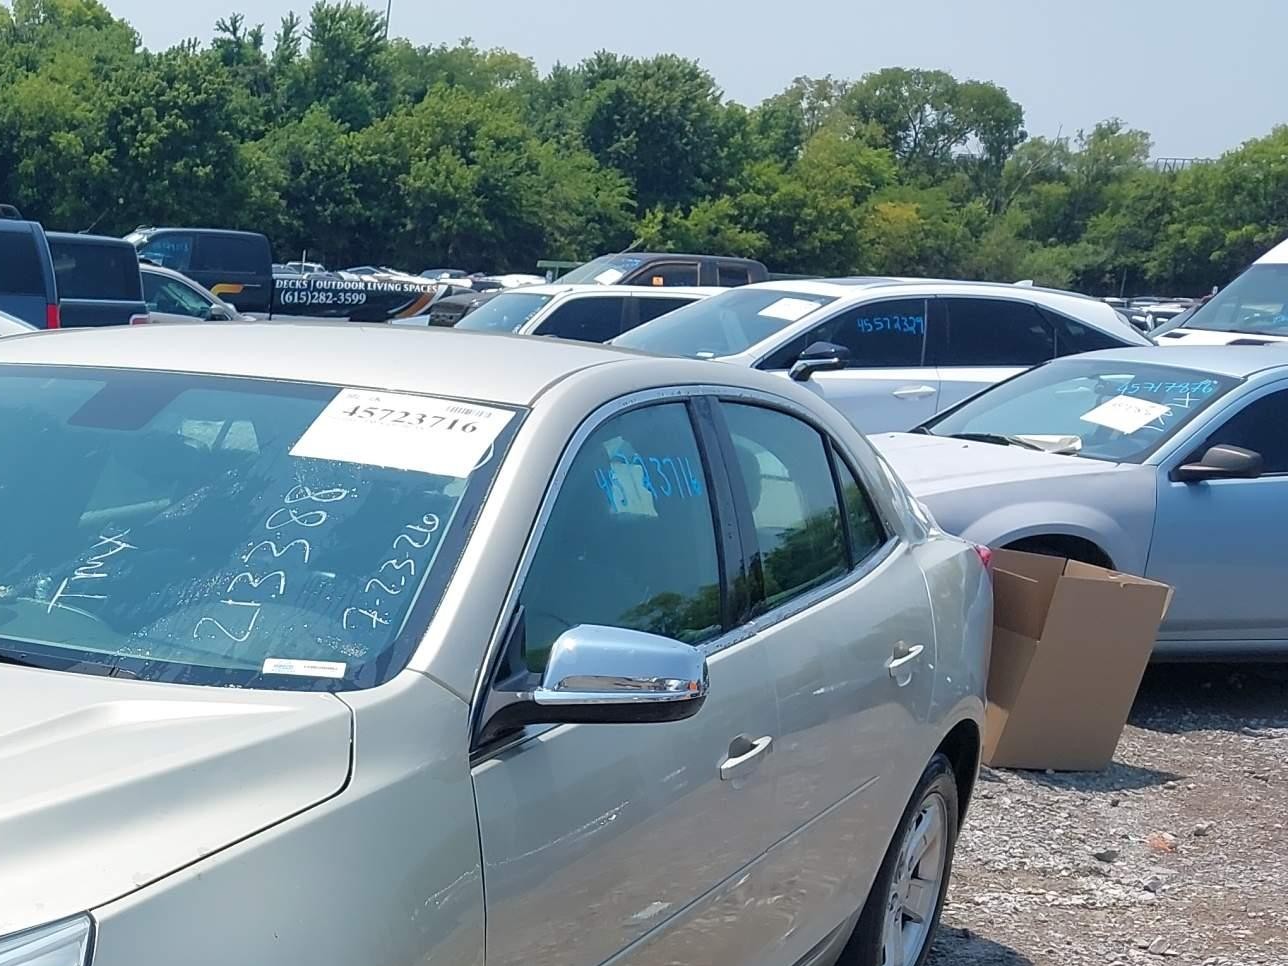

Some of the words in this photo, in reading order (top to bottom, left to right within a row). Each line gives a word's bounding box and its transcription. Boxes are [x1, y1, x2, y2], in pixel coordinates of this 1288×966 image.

[275, 279, 308, 290] DECKS
[315, 280, 366, 291] OUTDOOR
[367, 282, 401, 292] LIVING
[402, 283, 438, 294] SPACES
[280, 290, 367, 305] (615)282-3599
[342, 404, 479, 435] 45723716
[193, 484, 348, 642] 213388
[342, 513, 440, 630] 7-23-26
